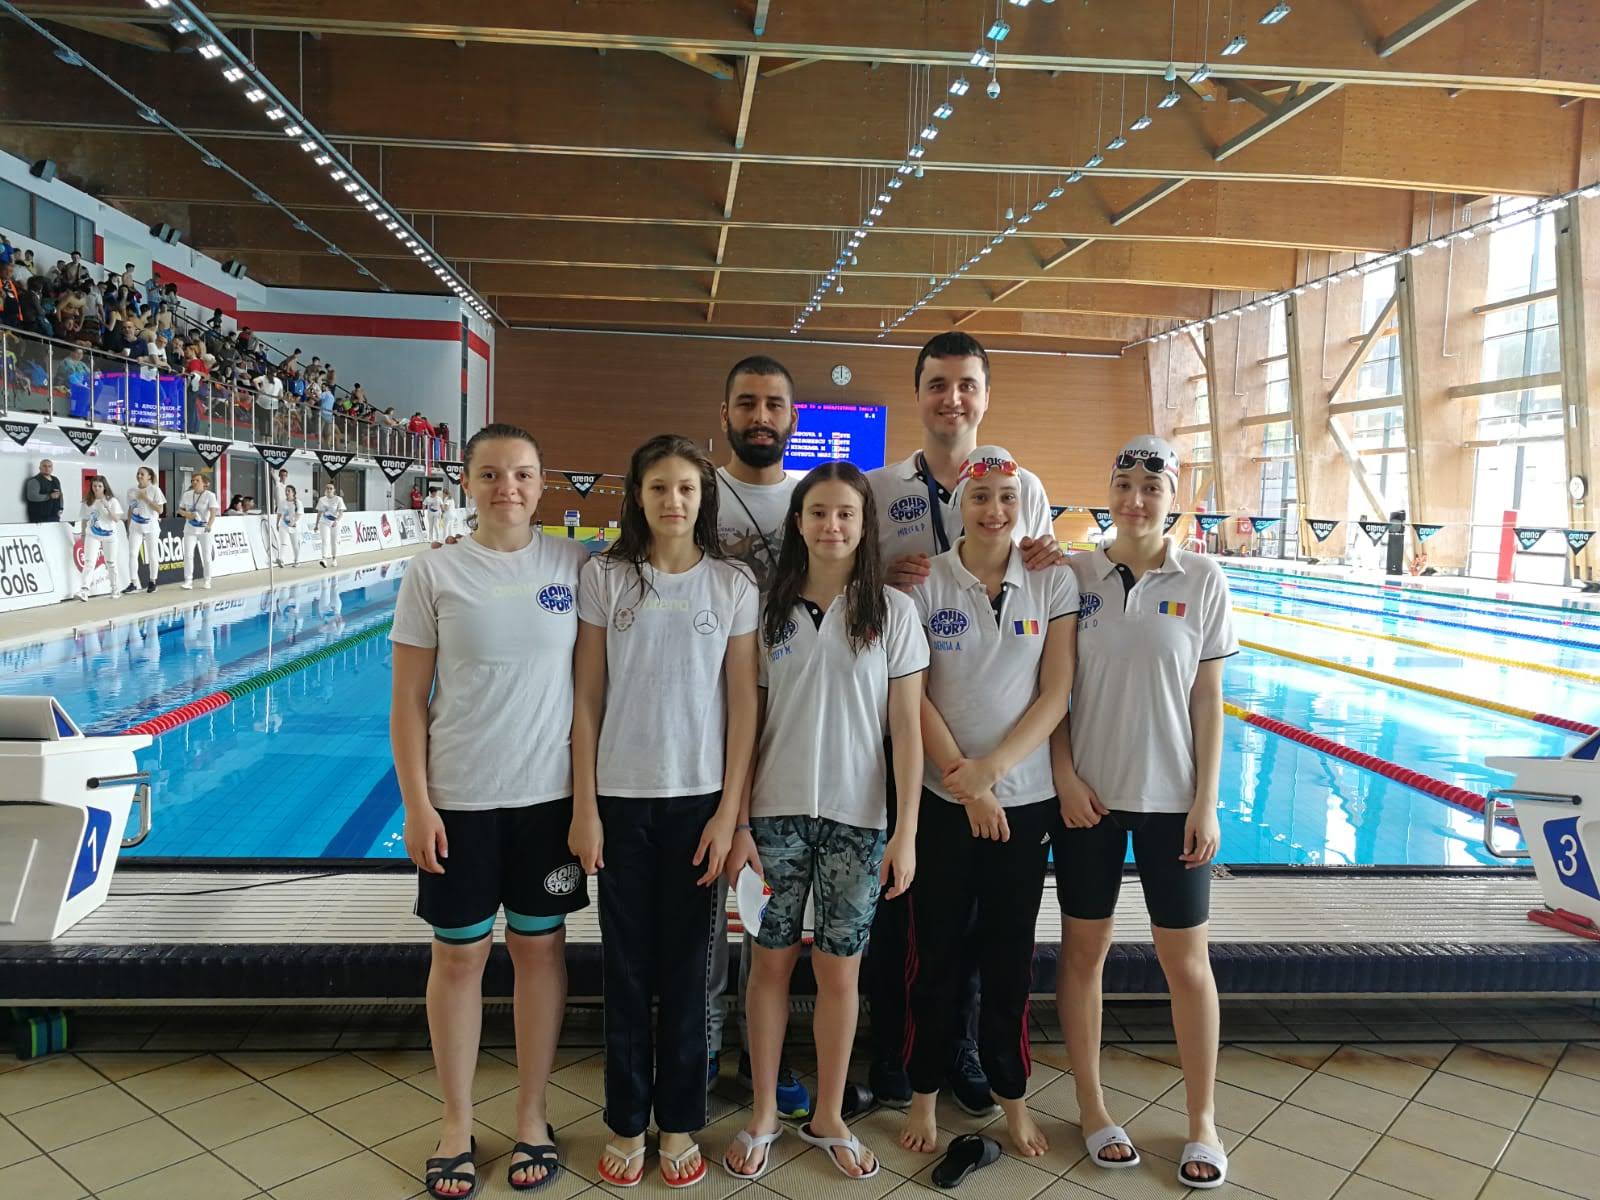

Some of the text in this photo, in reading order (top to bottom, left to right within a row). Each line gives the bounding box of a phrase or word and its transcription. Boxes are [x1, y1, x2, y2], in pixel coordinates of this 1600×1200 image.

[5, 424, 30, 433] arena
[69, 430, 93, 439] arena
[132, 436, 157, 445] arena
[198, 443, 222, 452] arena
[263, 449, 287, 458] arena
[322, 454, 346, 463] arena
[382, 459, 406, 468] arena
[446, 465, 464, 474] aren
[571, 475, 595, 483] arena
[891, 507, 926, 520] SPORT
[1313, 522, 1333, 531] arena
[1366, 524, 1386, 532] arena
[1520, 531, 1540, 539] arena
[1569, 533, 1589, 541] arena
[0, 538, 44, 573] yrtha
[0, 567, 38, 596] ools
[931, 623, 967, 635] SPORT
[88, 826, 97, 872] 1
[1558, 834, 1577, 876] 3
